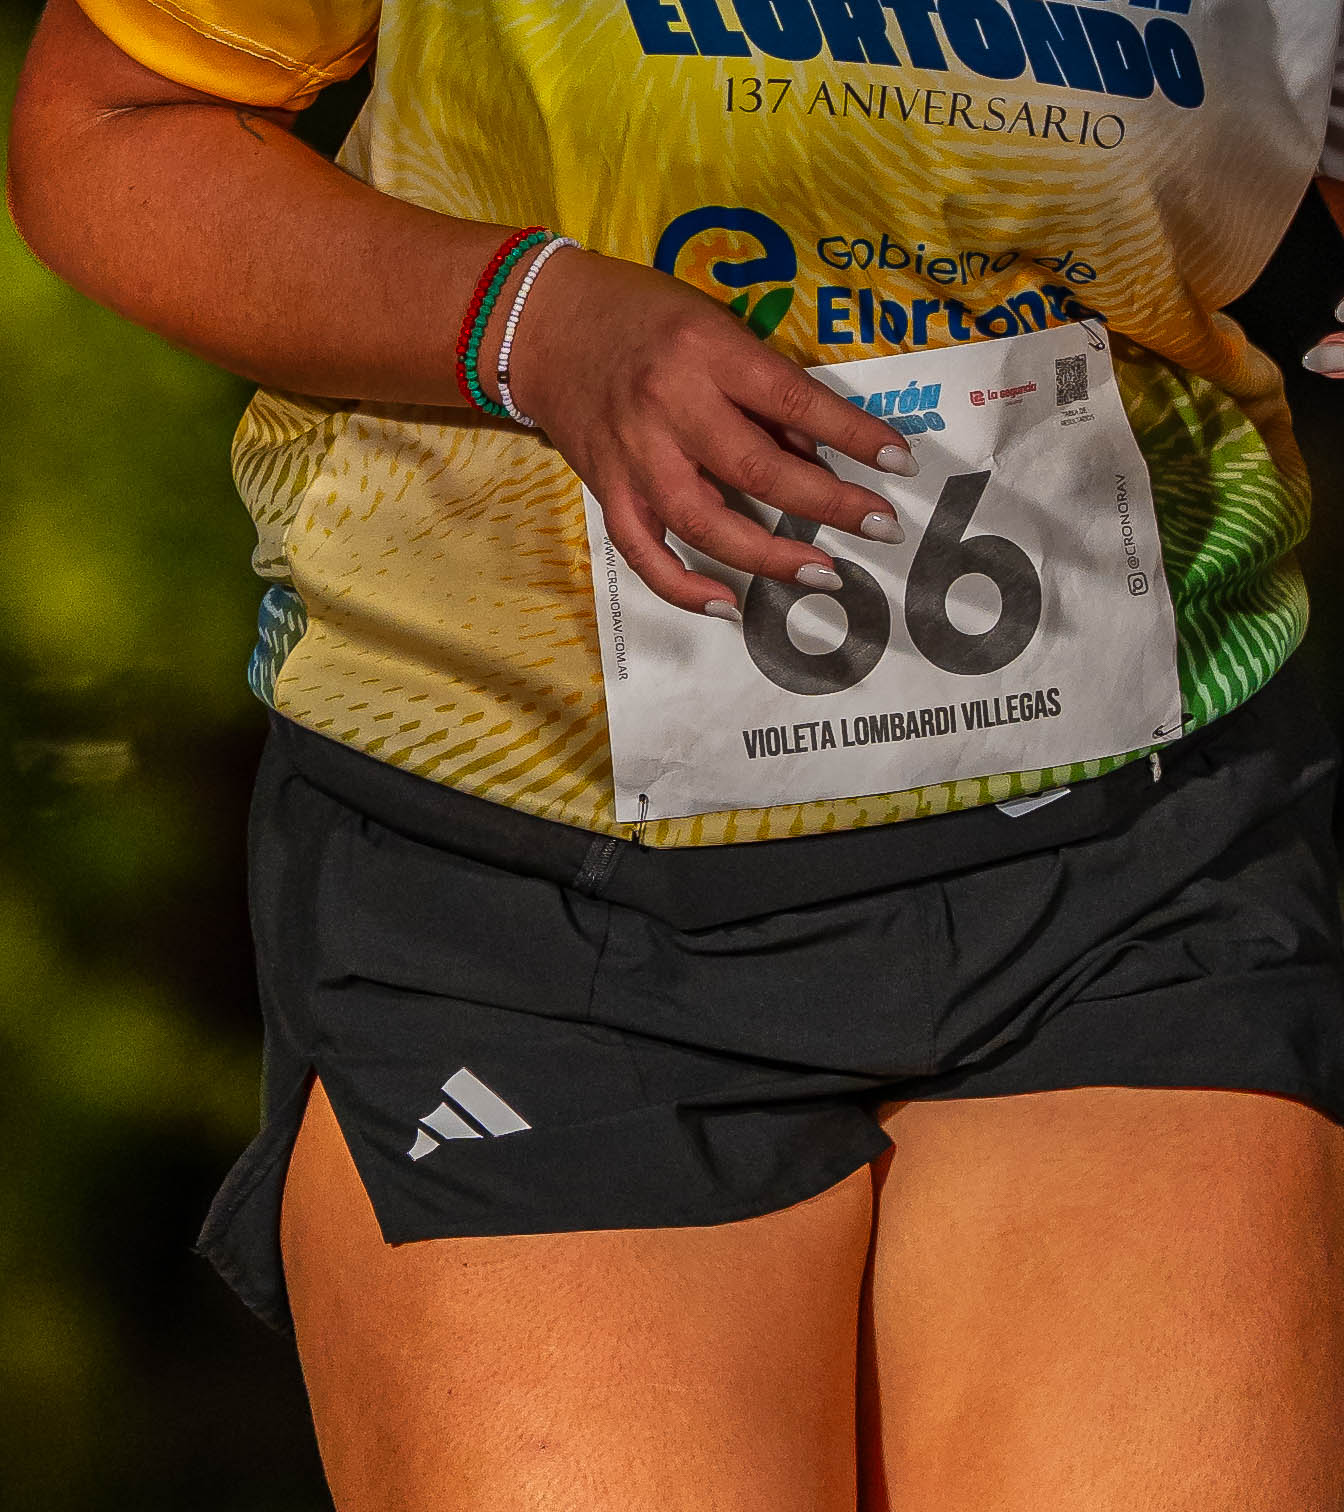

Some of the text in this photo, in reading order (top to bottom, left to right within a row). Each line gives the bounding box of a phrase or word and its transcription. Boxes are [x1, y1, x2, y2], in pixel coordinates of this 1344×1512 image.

[726, 78, 1125, 149] 137 ANIVERSARIO
[1032, 250, 1097, 284] de
[1115, 474, 1140, 569] @CRONORAV
[743, 470, 1042, 696] 66
[742, 687, 1062, 759] VIOLETA LOMBARDI VILLEGAS
